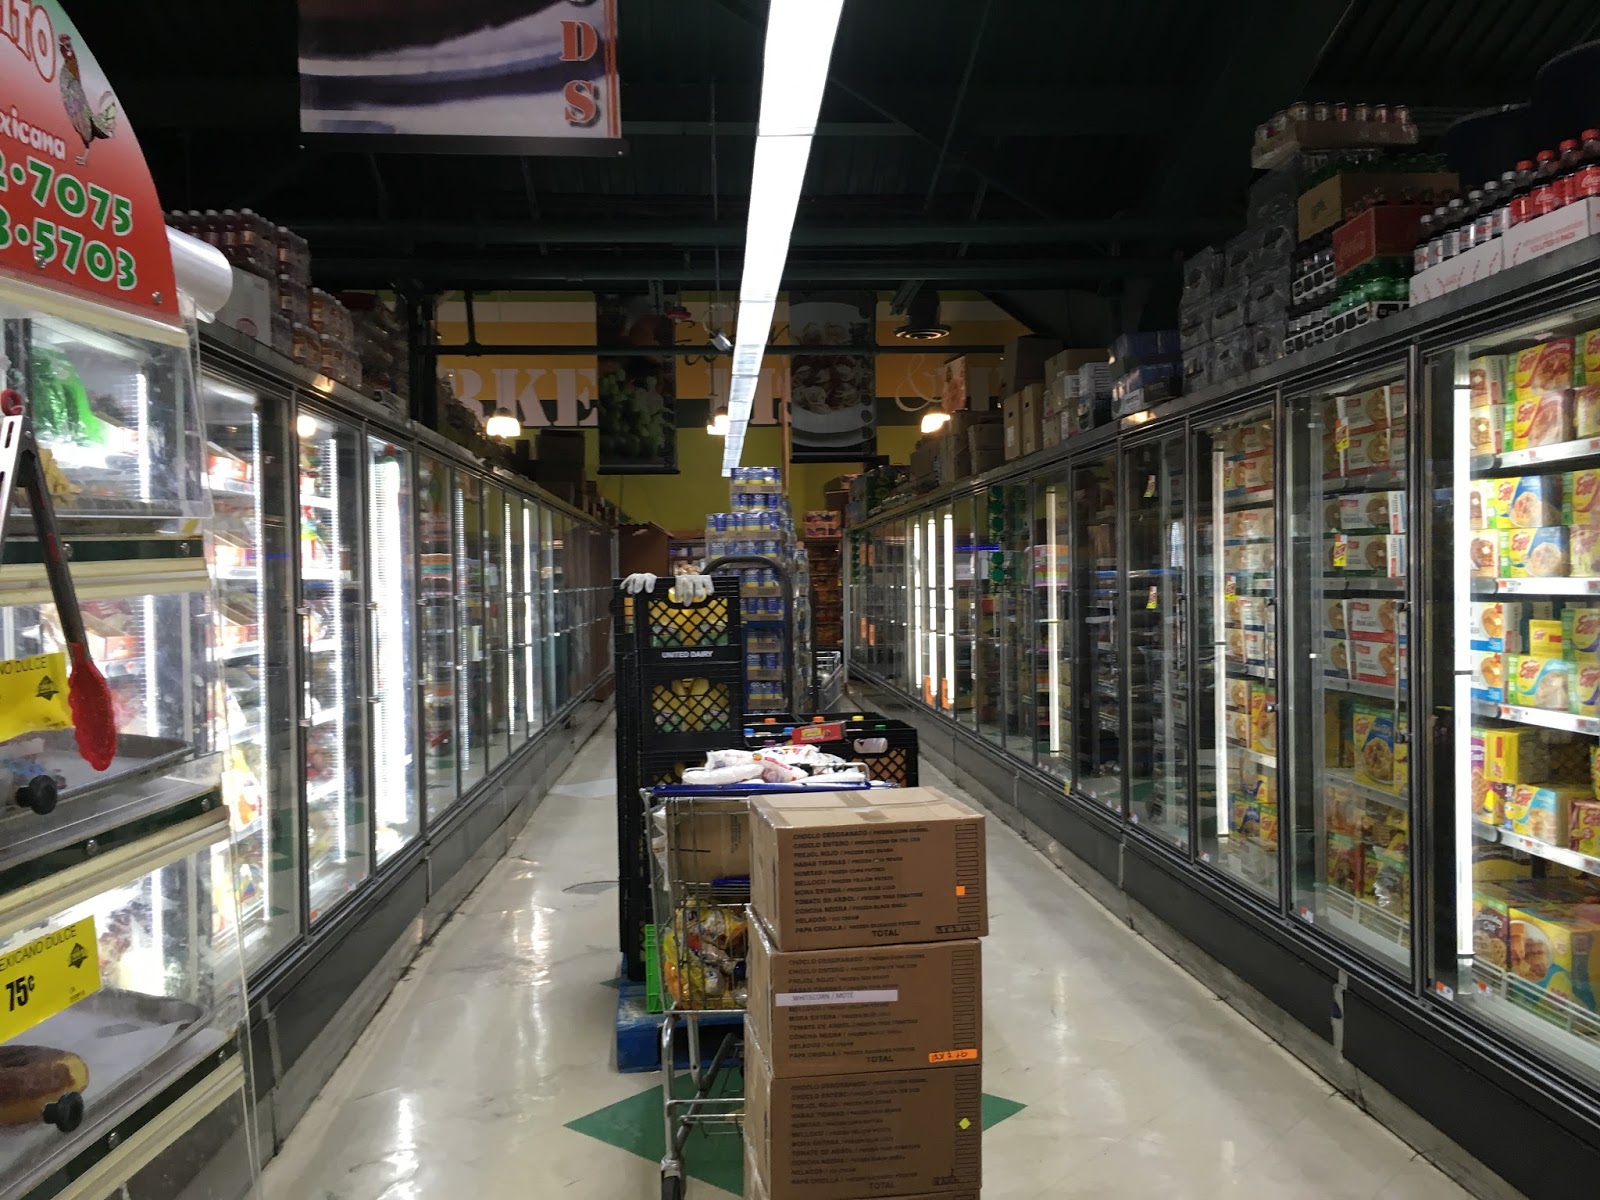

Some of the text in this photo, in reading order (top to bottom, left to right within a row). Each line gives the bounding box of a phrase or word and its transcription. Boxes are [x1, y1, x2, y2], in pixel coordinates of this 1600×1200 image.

[16, 656, 47, 673] DULCE
[46, 925, 76, 950] DULCE
[792, 992, 830, 1001] WHITECORN
[869, 1181, 896, 1190] TOTAL
